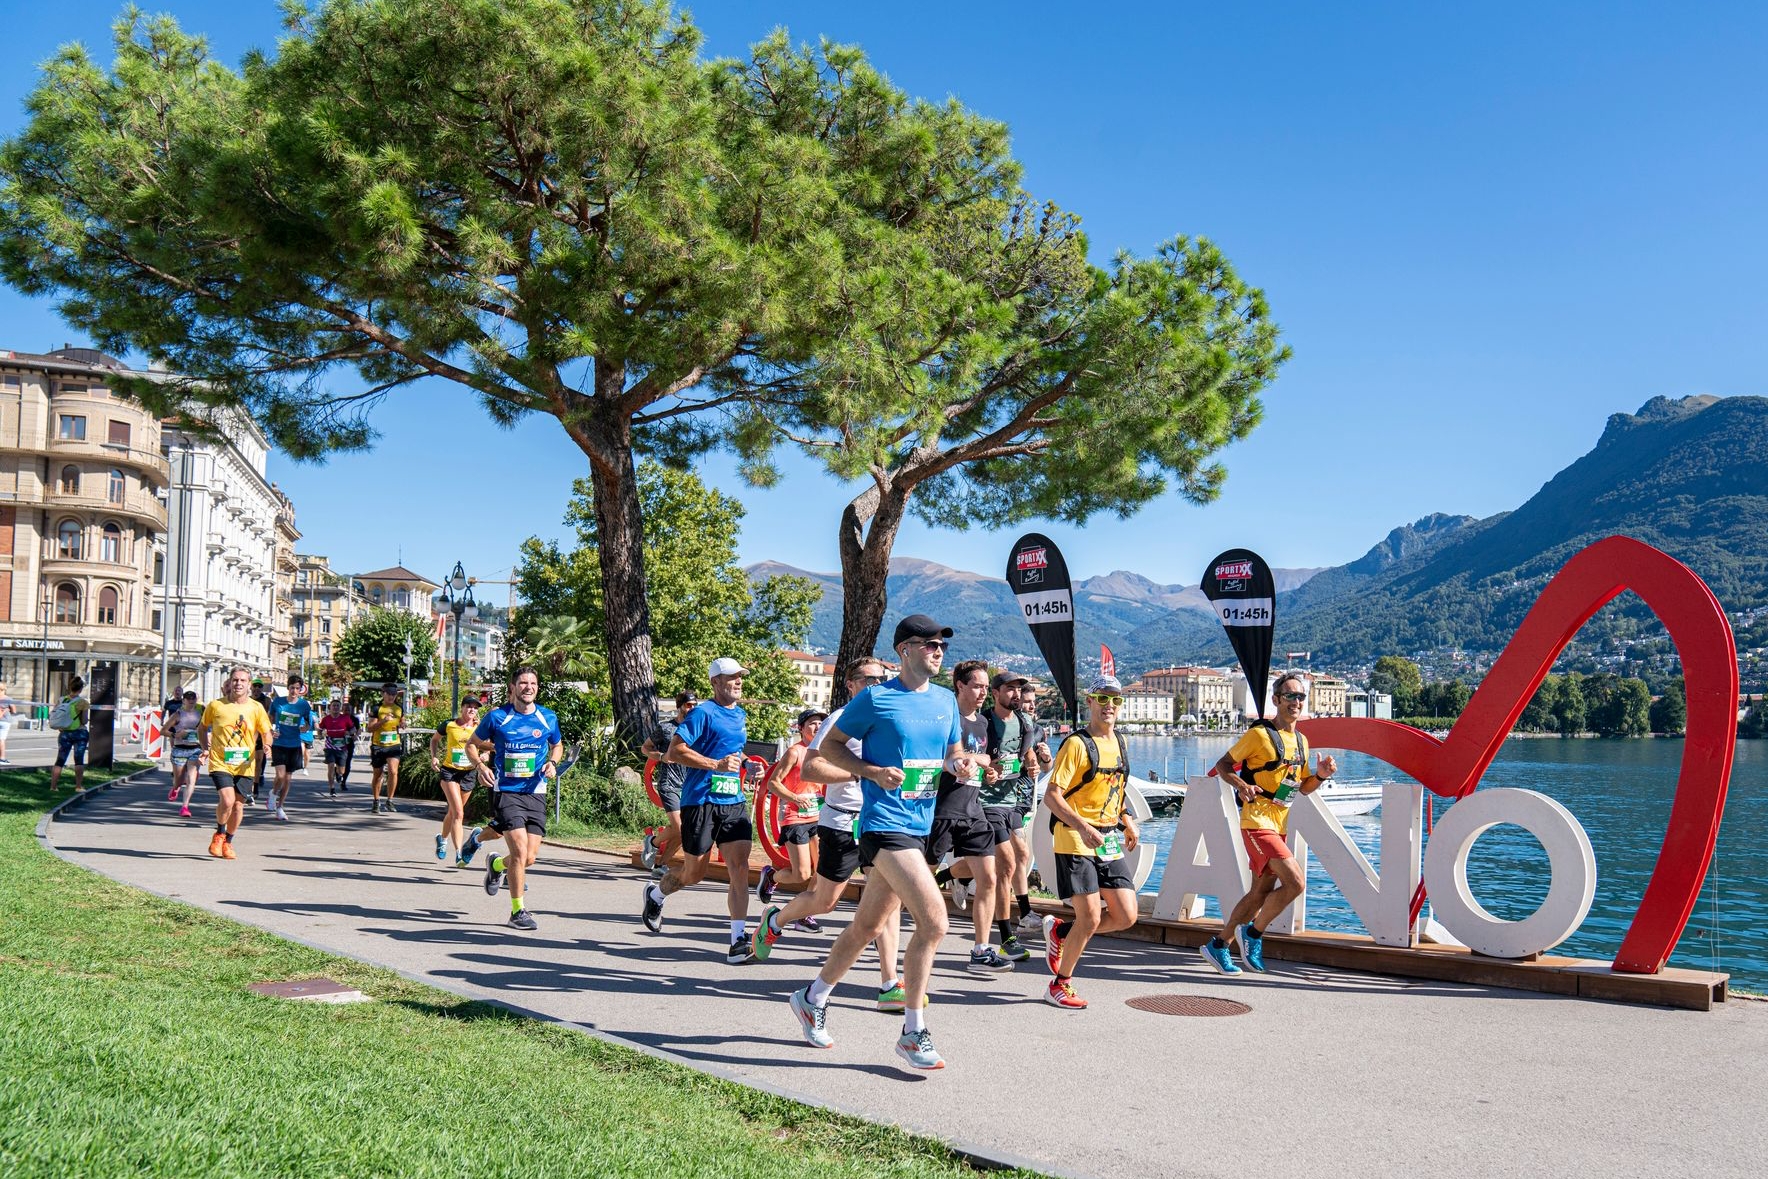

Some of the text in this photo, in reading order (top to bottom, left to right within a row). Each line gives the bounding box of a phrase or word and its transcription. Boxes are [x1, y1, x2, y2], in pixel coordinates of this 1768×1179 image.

[1016, 550, 1048, 565] SPORTXX
[1215, 563, 1253, 576] SPORTXX
[1025, 601, 1068, 616] 01:45h
[1223, 608, 1269, 619] 01:45h
